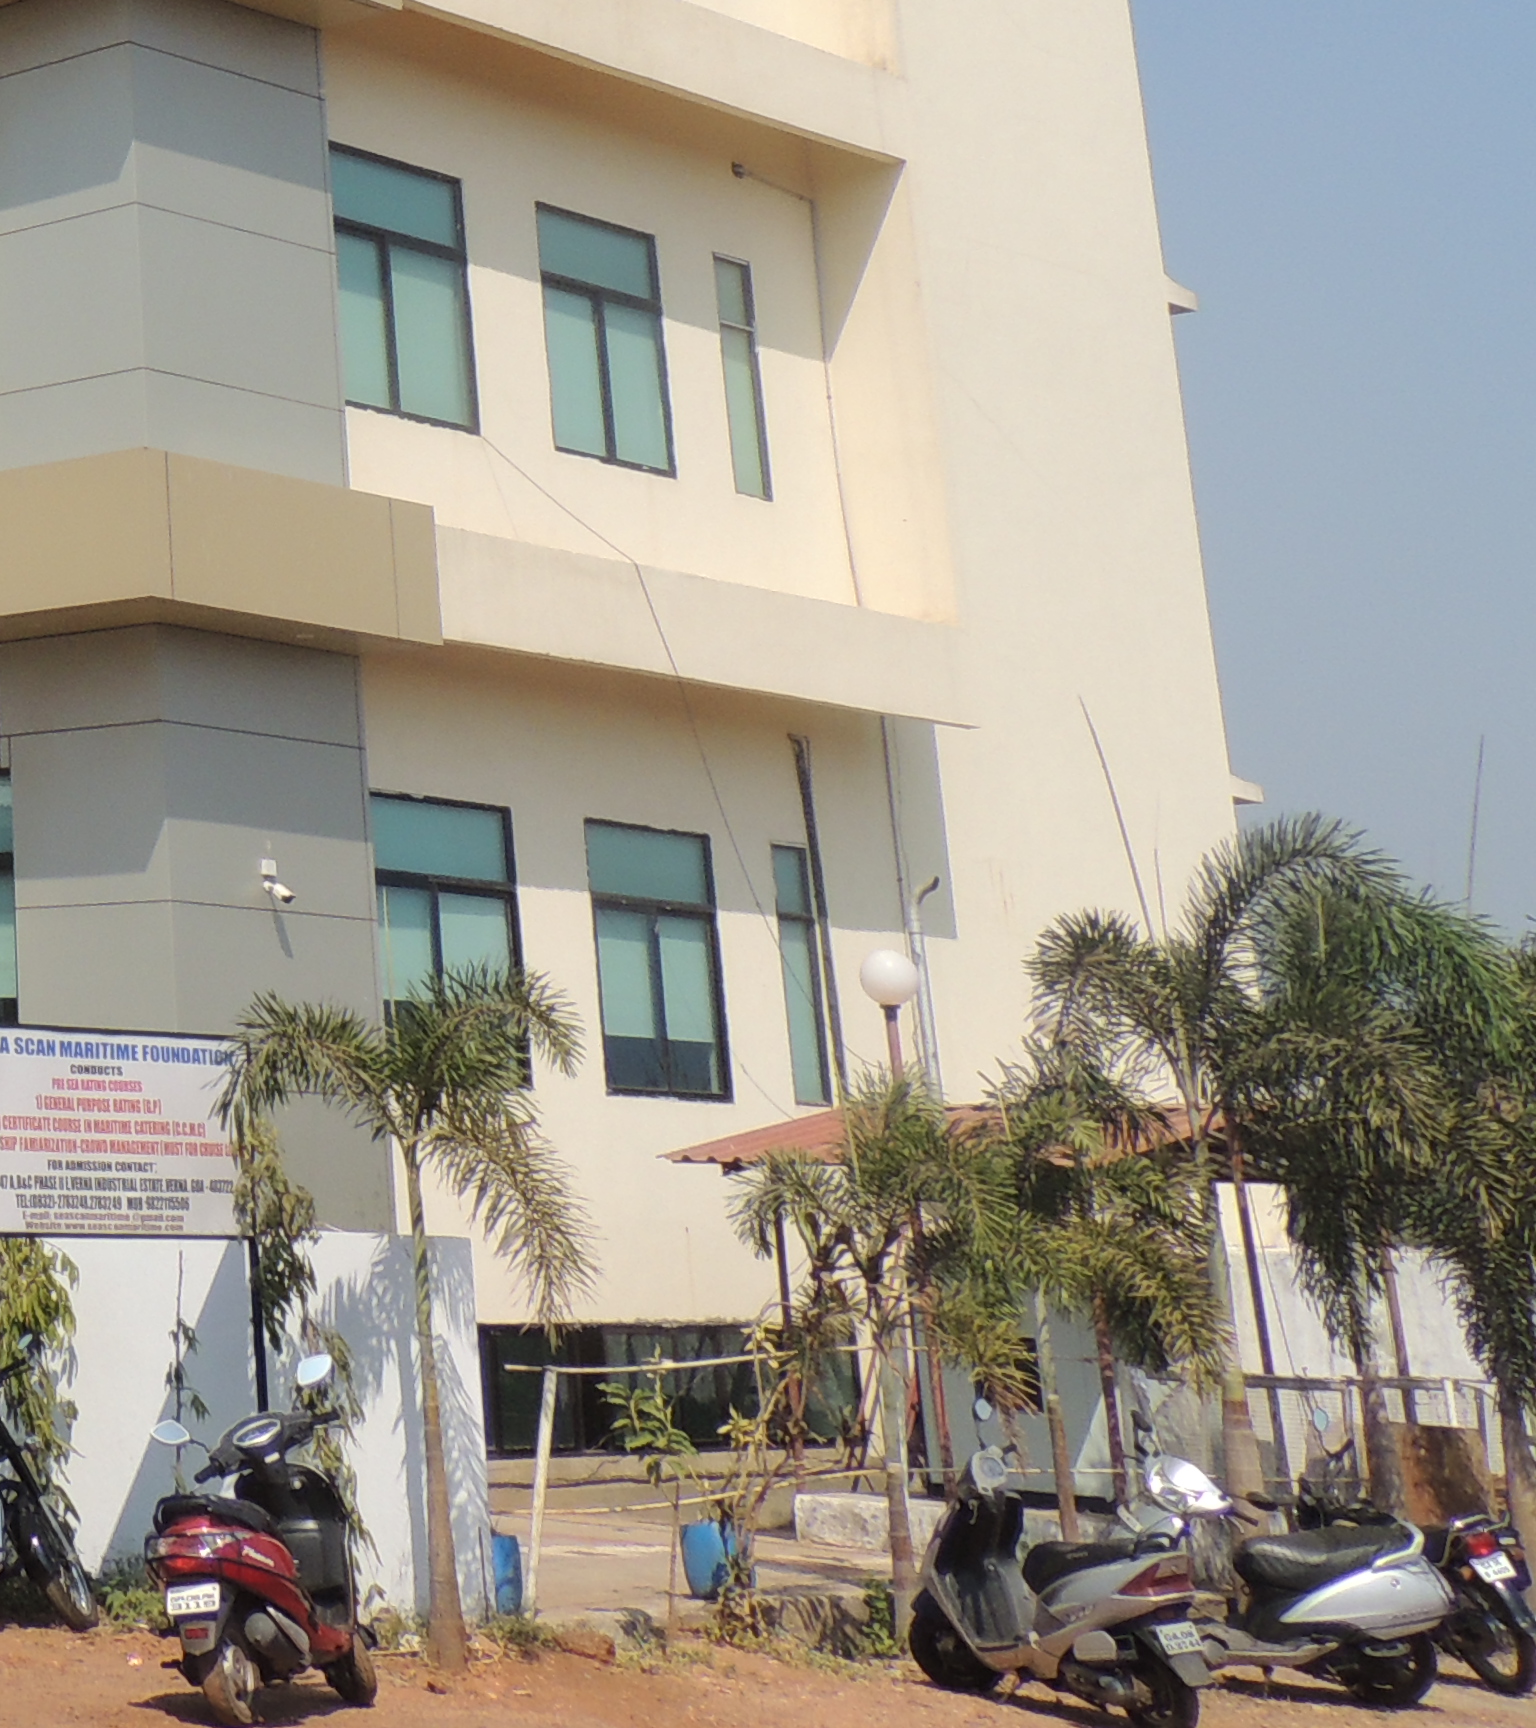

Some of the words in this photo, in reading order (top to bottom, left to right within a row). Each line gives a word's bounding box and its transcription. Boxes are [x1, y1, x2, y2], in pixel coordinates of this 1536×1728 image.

[14, 1036, 56, 1058] SCAN
[59, 1040, 139, 1062] MARITIME
[70, 1063, 123, 1076] CONDUCTS
[52, 1077, 65, 1090] PRE
[66, 1078, 79, 1091] SEA
[81, 1079, 107, 1092] RATING
[108, 1080, 143, 1093] COURSES
[44, 1095, 76, 1111] GENERAL
[77, 1097, 111, 1113] PURPOSE
[113, 1098, 141, 1114] RATING
[2, 1115, 51, 1132] CERTIFICATE
[53, 1117, 82, 1133] COURSE
[94, 1119, 132, 1135] MARITIME
[134, 1120, 171, 1136] CATERING
[47, 1159, 63, 1171] FOR
[65, 1160, 113, 1172] ADMISSION
